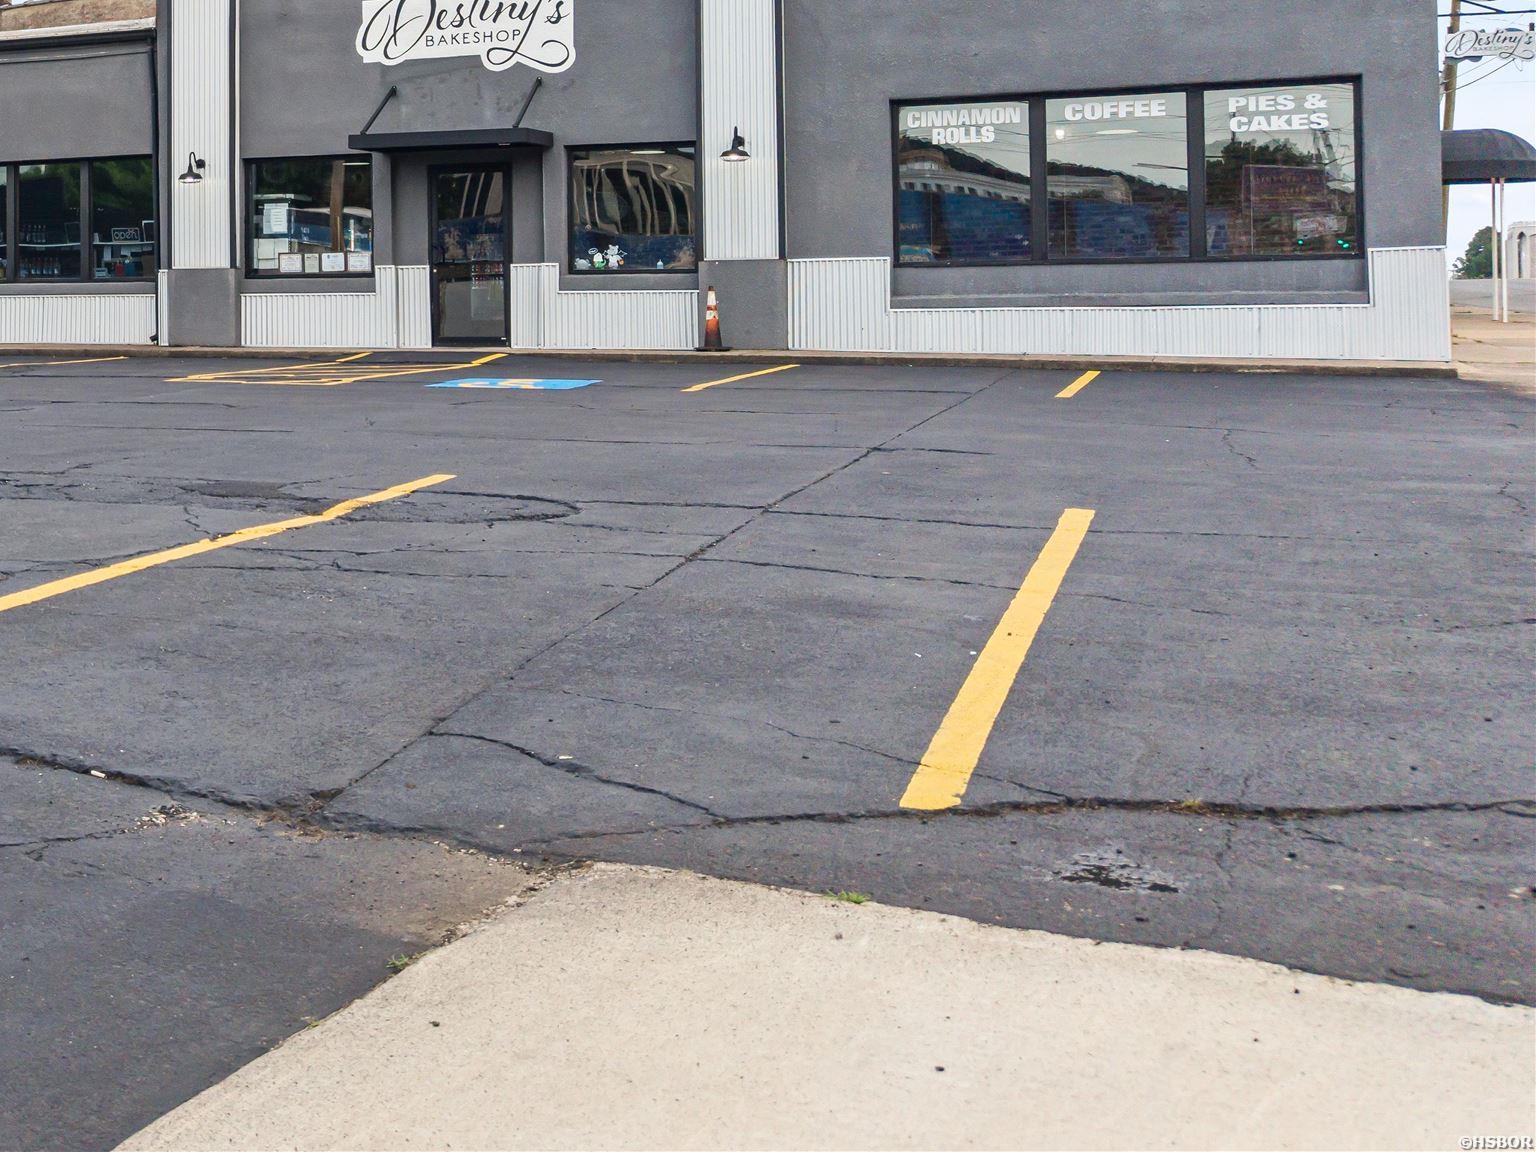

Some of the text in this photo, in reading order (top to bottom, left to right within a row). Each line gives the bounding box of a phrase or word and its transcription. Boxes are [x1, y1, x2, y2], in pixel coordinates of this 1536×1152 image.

[425, 29, 521, 47] BAKESHOP
[1445, 30, 1534, 59] Destiny's
[1064, 99, 1167, 121] COFFEE
[1228, 93, 1328, 113] PIES &
[907, 108, 1021, 128] CINNAMON
[1229, 112, 1330, 132] CAKES
[931, 125, 995, 145] ROLLS
